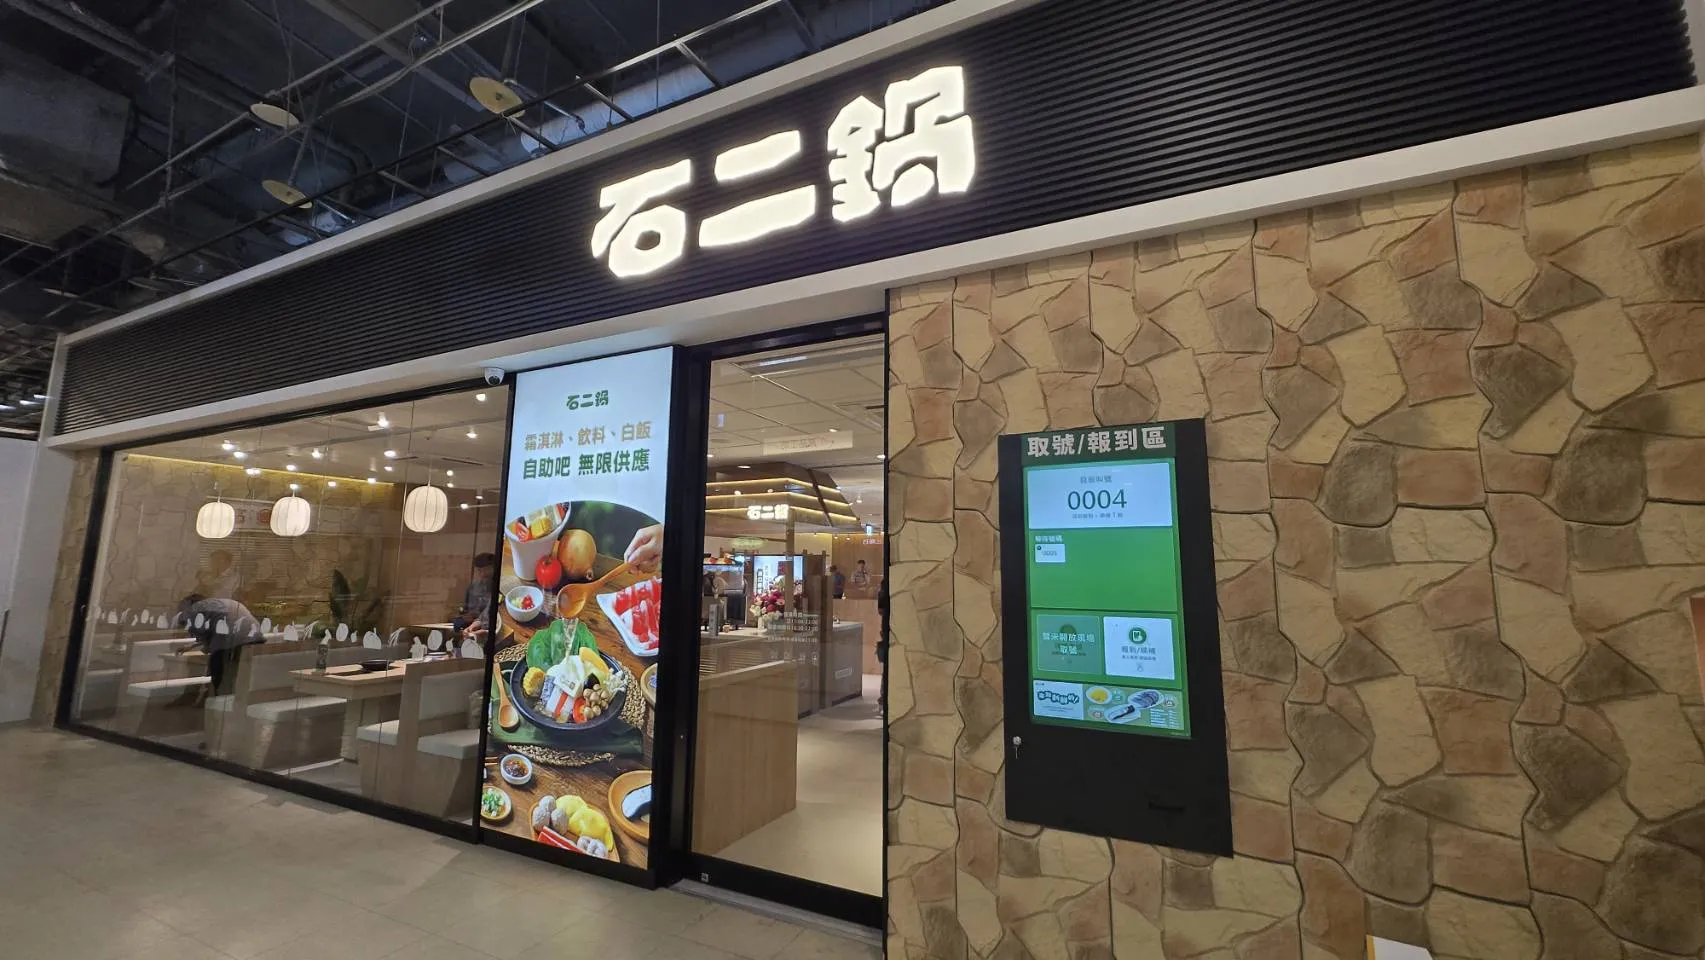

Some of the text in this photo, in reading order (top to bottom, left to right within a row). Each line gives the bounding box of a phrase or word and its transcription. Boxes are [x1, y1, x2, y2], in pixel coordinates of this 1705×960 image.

[591, 65, 976, 278] 石二鍋
[566, 390, 609, 410] 石二鍋
[1027, 426, 1167, 458] 取號/報到區
[523, 448, 650, 479] 自助吧 無限供應
[1067, 488, 1127, 510] 0004
